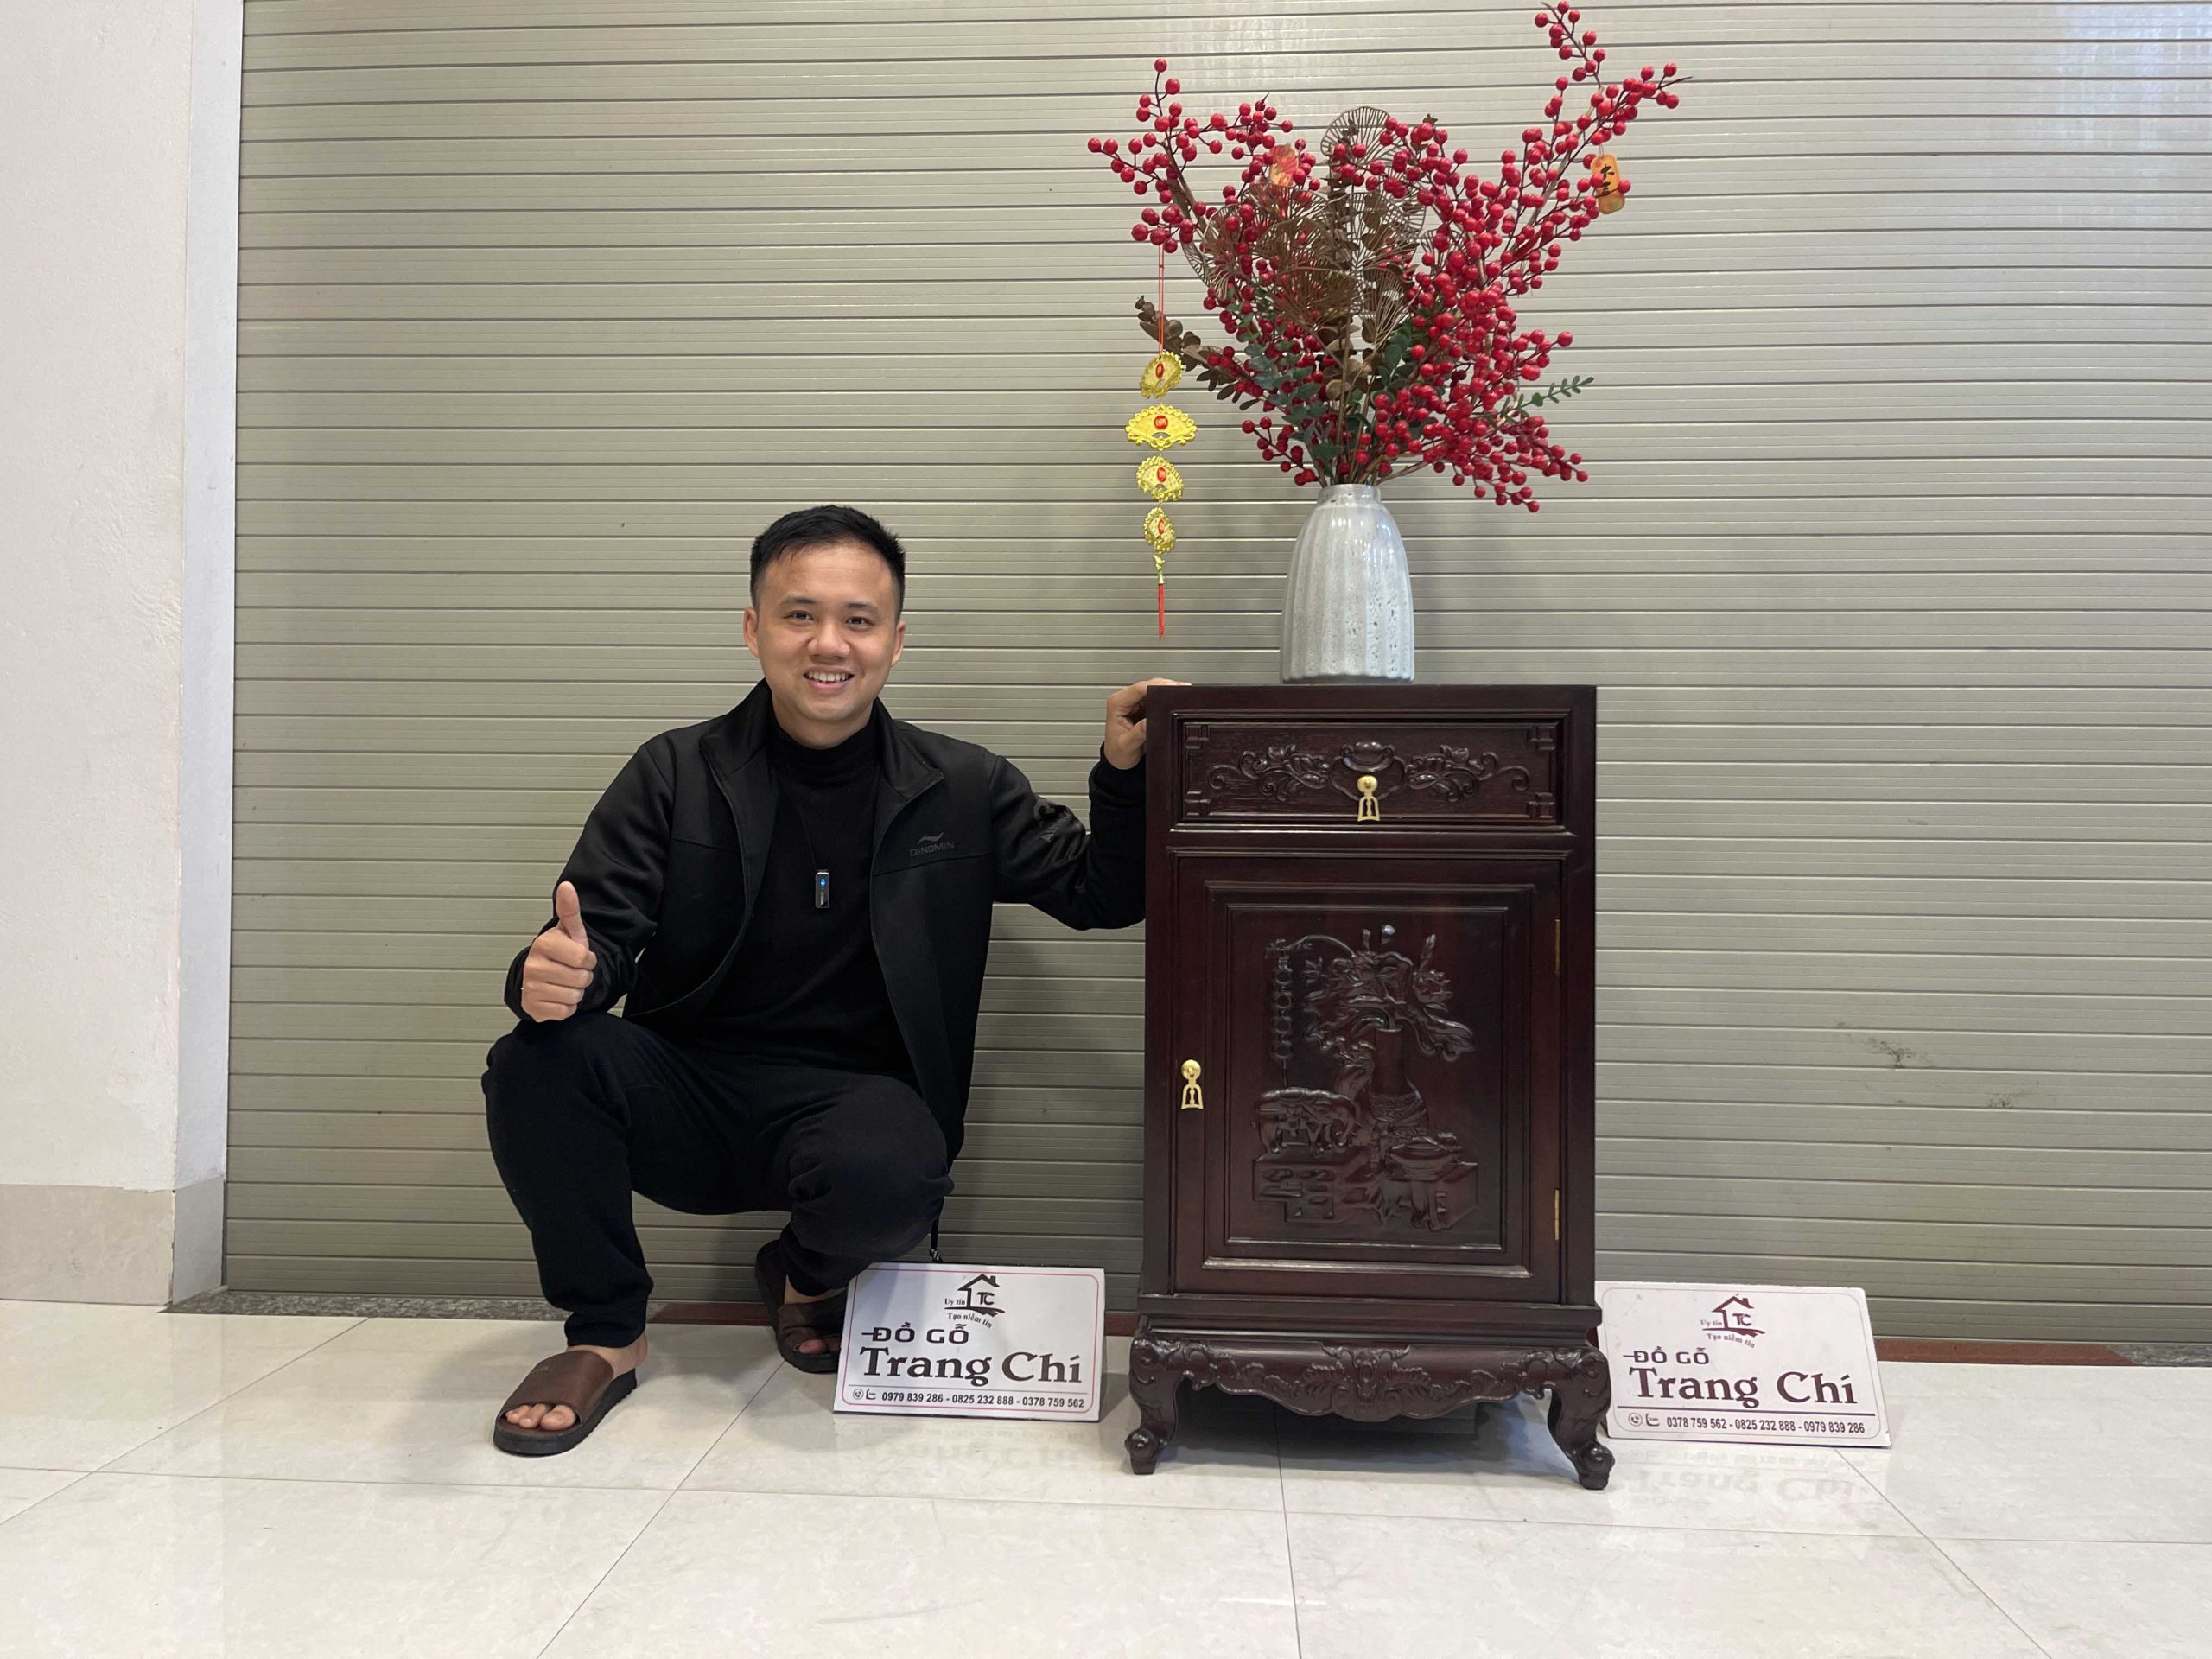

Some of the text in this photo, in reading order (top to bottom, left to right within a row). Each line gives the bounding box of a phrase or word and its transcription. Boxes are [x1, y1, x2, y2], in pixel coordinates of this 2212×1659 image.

[944, 1298, 954, 1306] Uy
[976, 1291, 995, 1306] TC
[1732, 1313, 1752, 1326] TC
[861, 1321, 969, 1344] ĐỒ GỖ
[1623, 1346, 1710, 1365] ĐỒ GỖ
[860, 1346, 1082, 1387] Trang Chí
[1629, 1366, 1858, 1409] Trang Chí
[881, 1392, 905, 1402] 0979
[906, 1393, 924, 1402] 839
[926, 1393, 943, 1403] 286
[952, 1394, 975, 1404] 0825
[976, 1395, 995, 1405] 232
[996, 1395, 1014, 1405] 888
[1022, 1396, 1045, 1407] 0378
[1048, 1397, 1065, 1408] 759
[1067, 1398, 1084, 1408] 562
[1666, 1416, 1689, 1427] 0378
[1691, 1417, 1707, 1428] 759
[1710, 1418, 1727, 1429] 562
[1735, 1419, 1758, 1430] 0825
[1759, 1420, 1777, 1431] 232
[1778, 1421, 1796, 1431] 888
[1804, 1421, 1827, 1432] 0979
[1828, 1421, 1846, 1433] 839
[1847, 1422, 1865, 1433] 286
